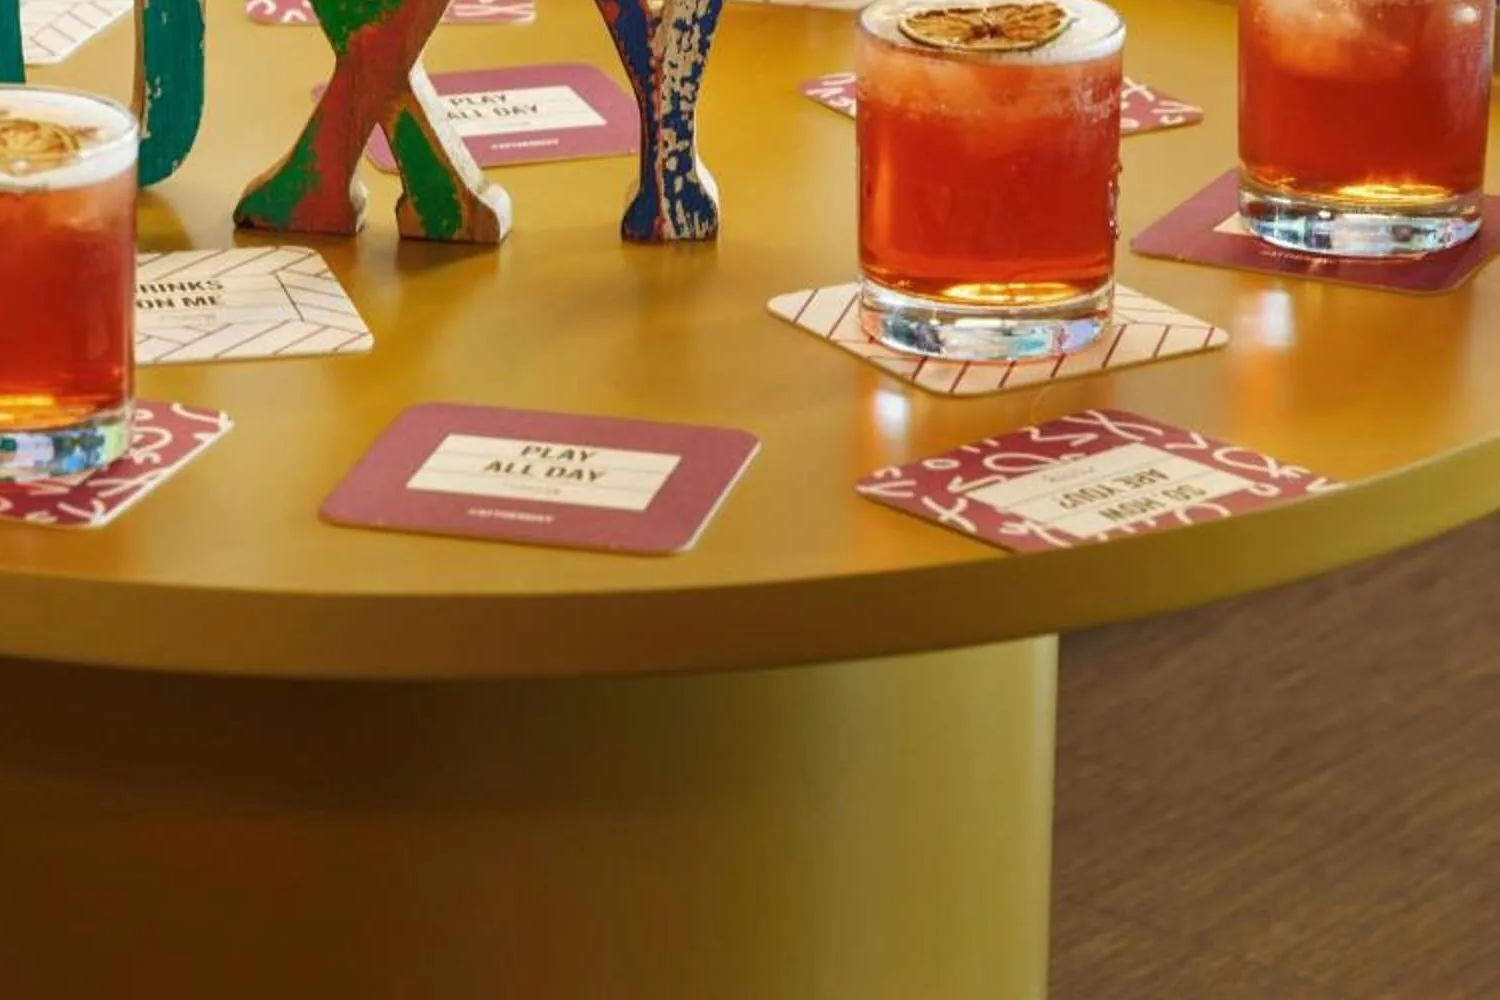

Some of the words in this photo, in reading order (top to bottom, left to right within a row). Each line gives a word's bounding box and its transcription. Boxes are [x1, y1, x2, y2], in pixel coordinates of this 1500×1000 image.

[449, 94, 507, 107] PLAY
[491, 103, 537, 117] DAY
[133, 280, 224, 294] RINKS
[520, 444, 598, 464] PLAY
[484, 460, 534, 477] ALL
[545, 466, 607, 484] DAY
